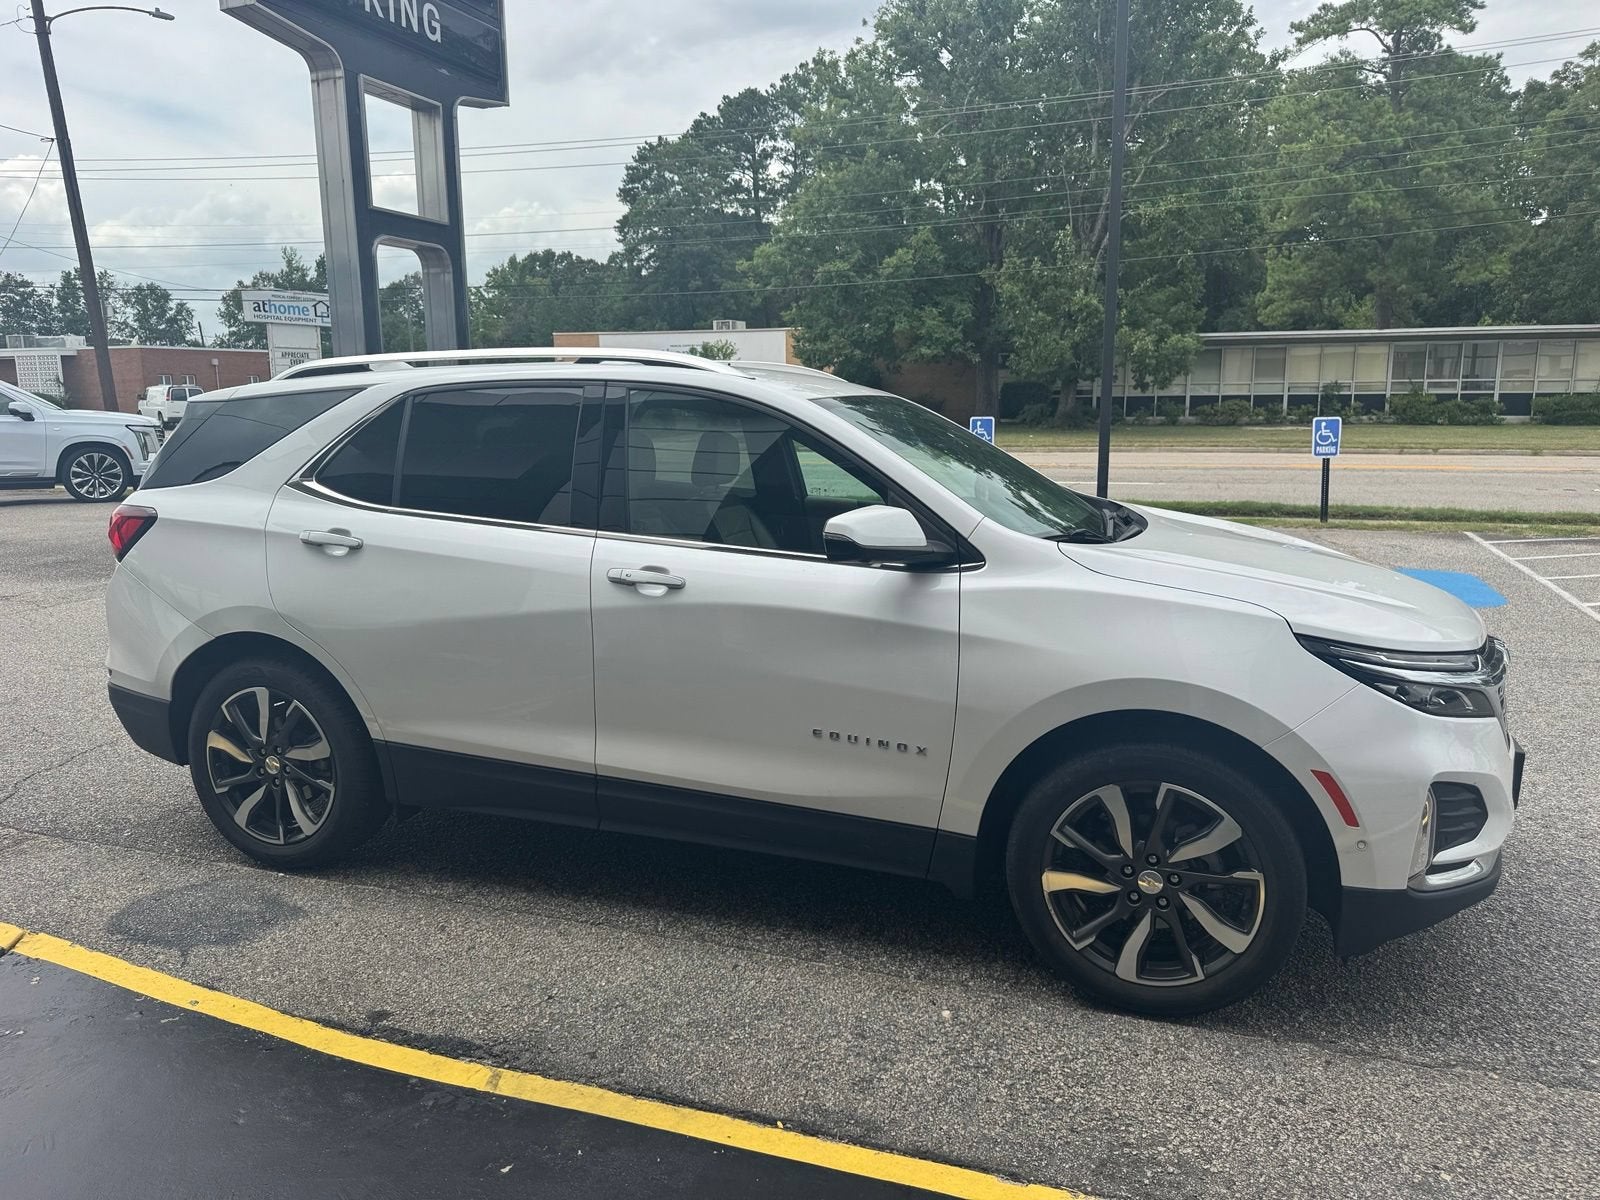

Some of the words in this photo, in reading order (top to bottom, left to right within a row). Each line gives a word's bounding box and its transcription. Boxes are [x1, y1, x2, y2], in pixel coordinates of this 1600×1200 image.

[252, 299, 310, 316] athome
[1316, 446, 1336, 454] PARKING
[812, 728, 928, 756] EQUINOX
